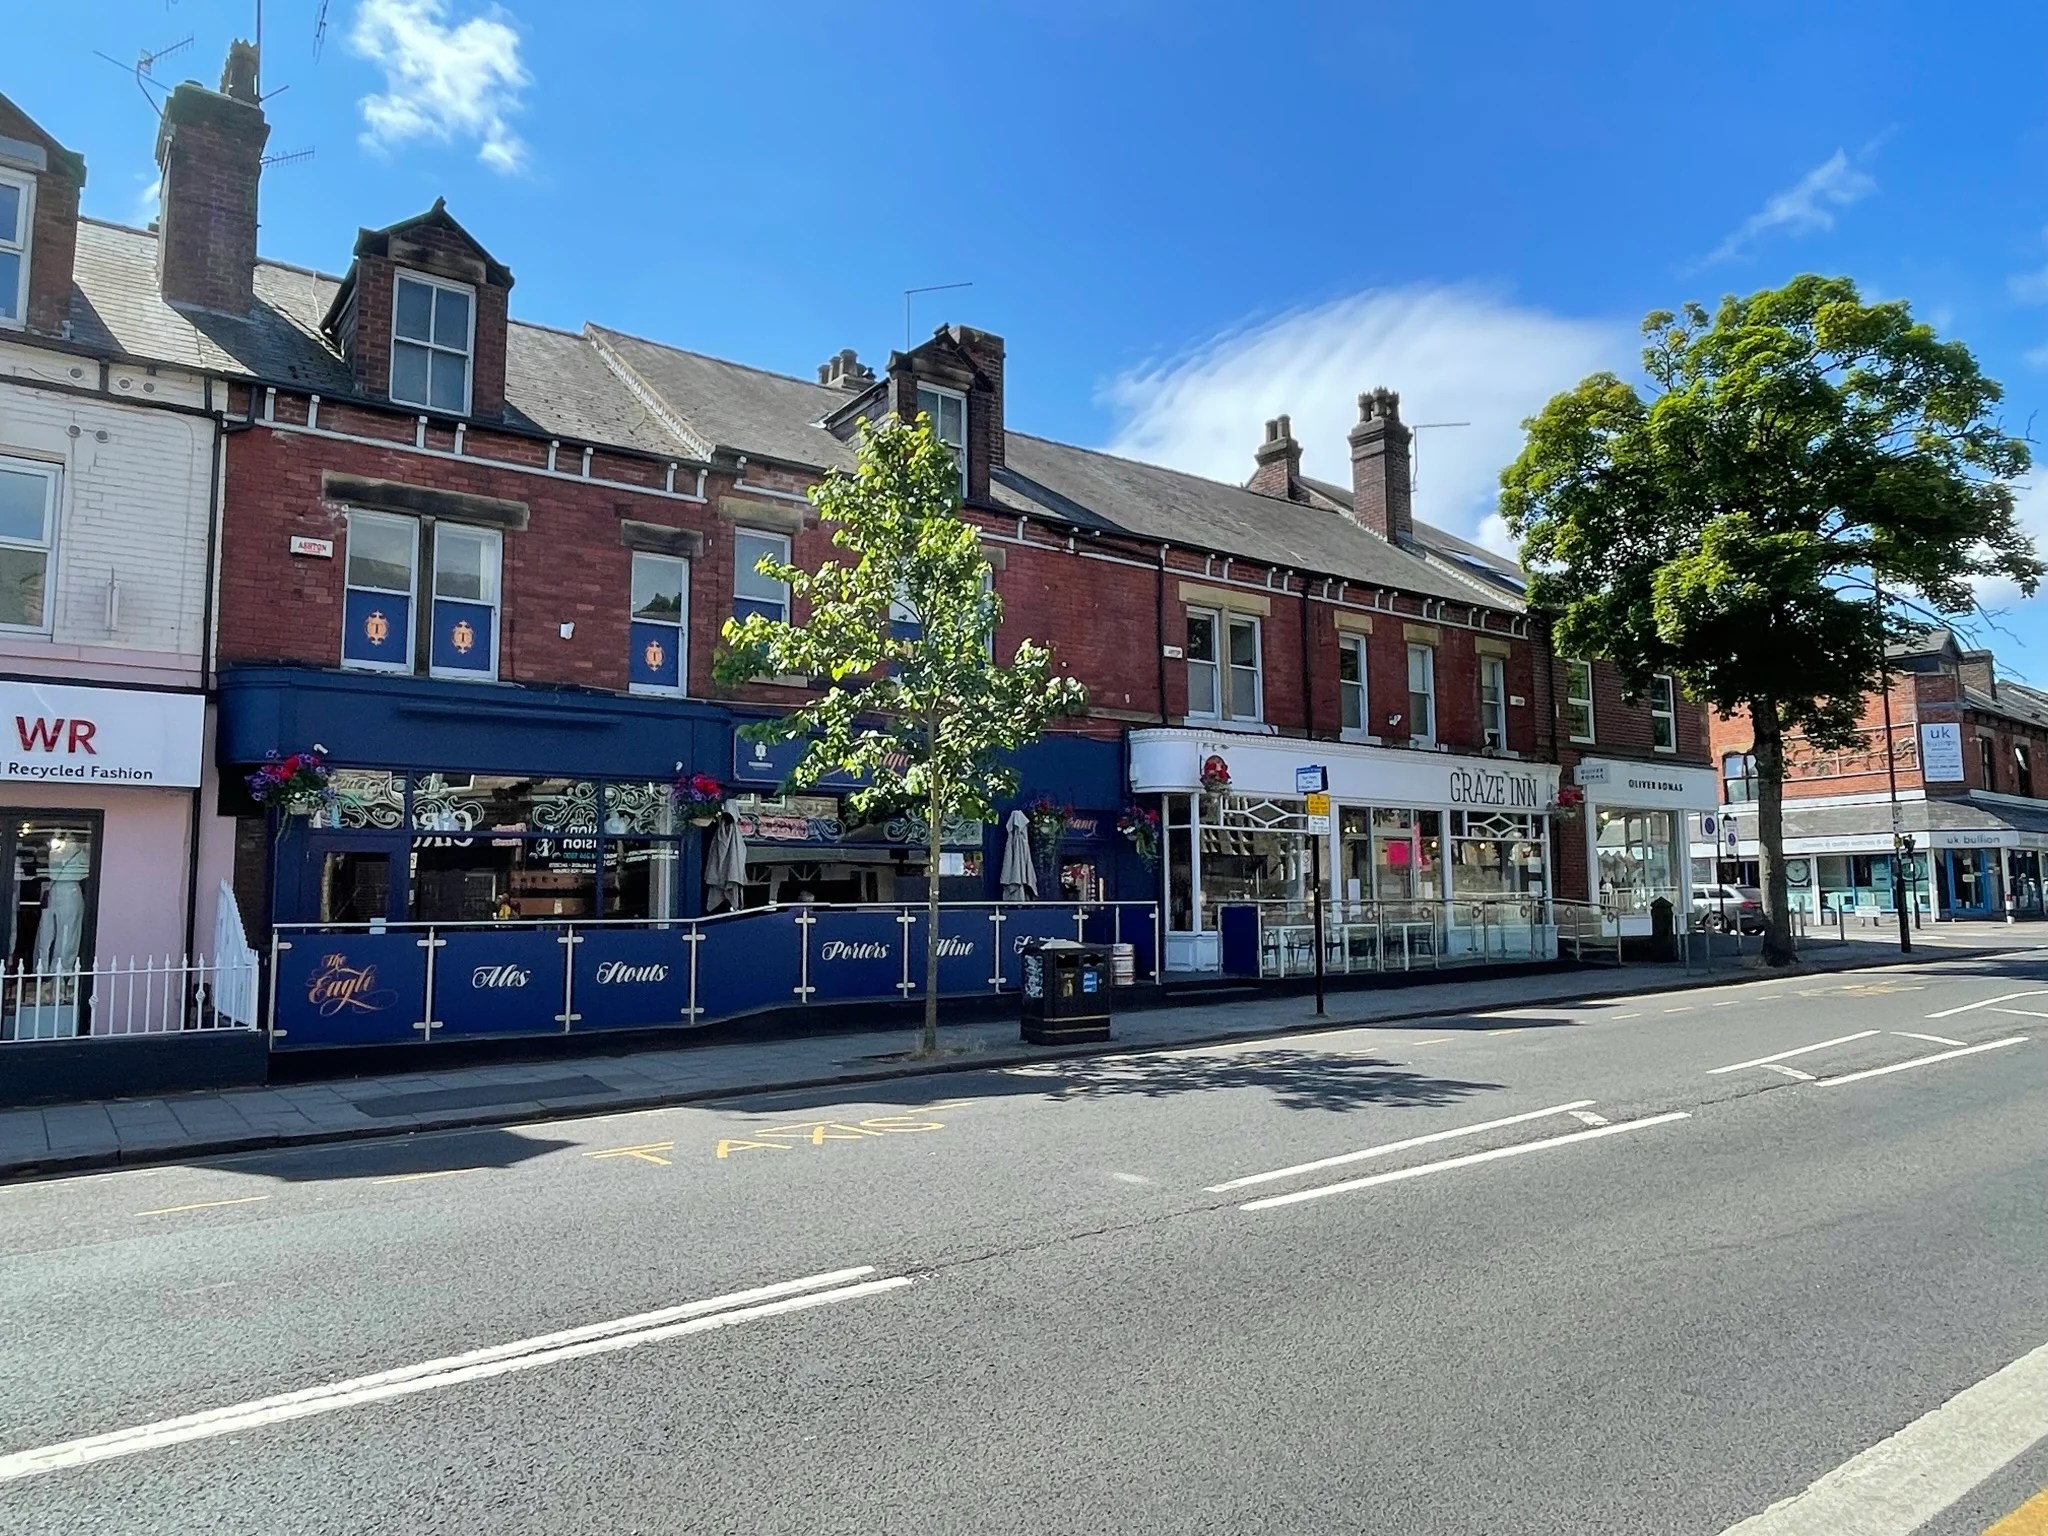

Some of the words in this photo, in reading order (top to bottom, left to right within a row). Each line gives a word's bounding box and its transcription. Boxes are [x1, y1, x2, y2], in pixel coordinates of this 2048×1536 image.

[15, 716, 98, 755] WR
[1930, 726, 1951, 739] uk
[8, 762, 85, 779] Recycled
[90, 765, 154, 780] Fashion
[1450, 772, 1505, 805] GRAZE
[1509, 776, 1538, 807] INN
[1628, 779, 1656, 790] OLIVER
[1947, 834, 1958, 845] uk
[1963, 834, 2001, 845] bullion
[821, 940, 890, 961] Porters
[934, 934, 974, 958] Wine
[471, 964, 531, 989] Ales
[596, 961, 669, 985] Stouts
[305, 965, 396, 1016] Eagle
